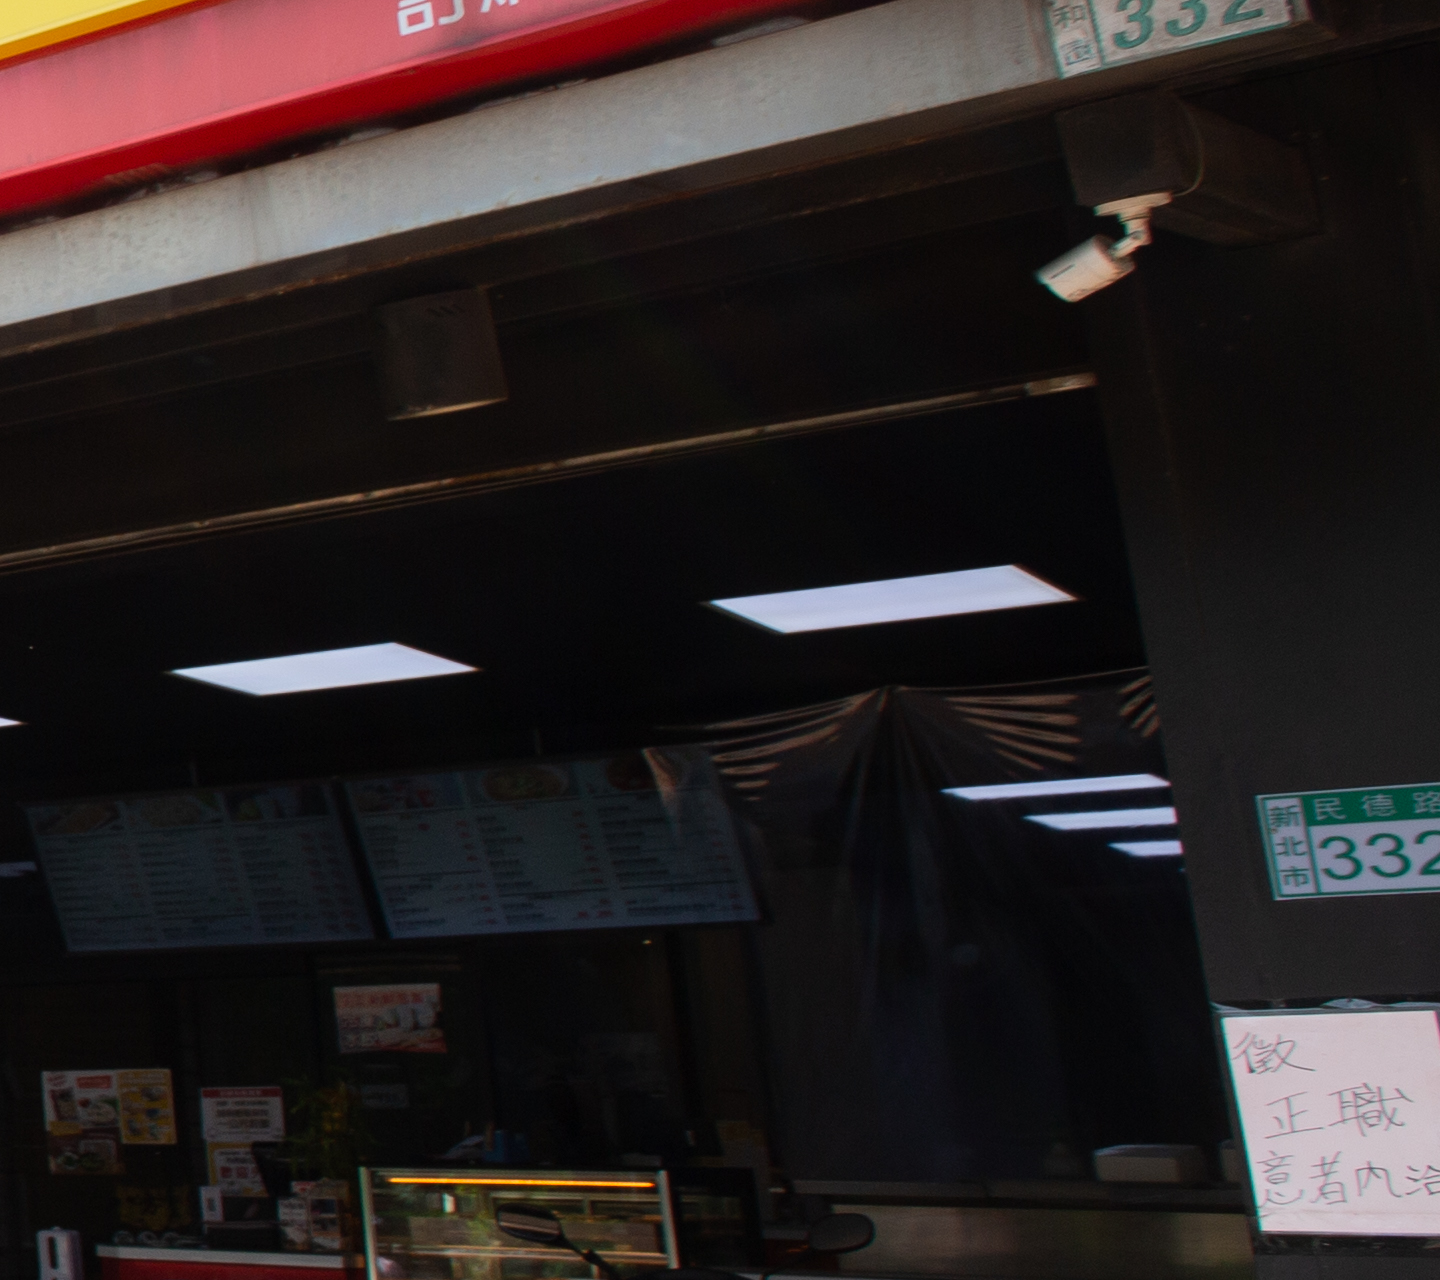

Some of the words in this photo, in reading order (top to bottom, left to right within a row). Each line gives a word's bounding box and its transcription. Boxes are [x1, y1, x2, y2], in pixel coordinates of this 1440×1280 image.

[1269, 804, 1311, 888] 新北市
[1265, 1082, 1414, 1138] 正職
